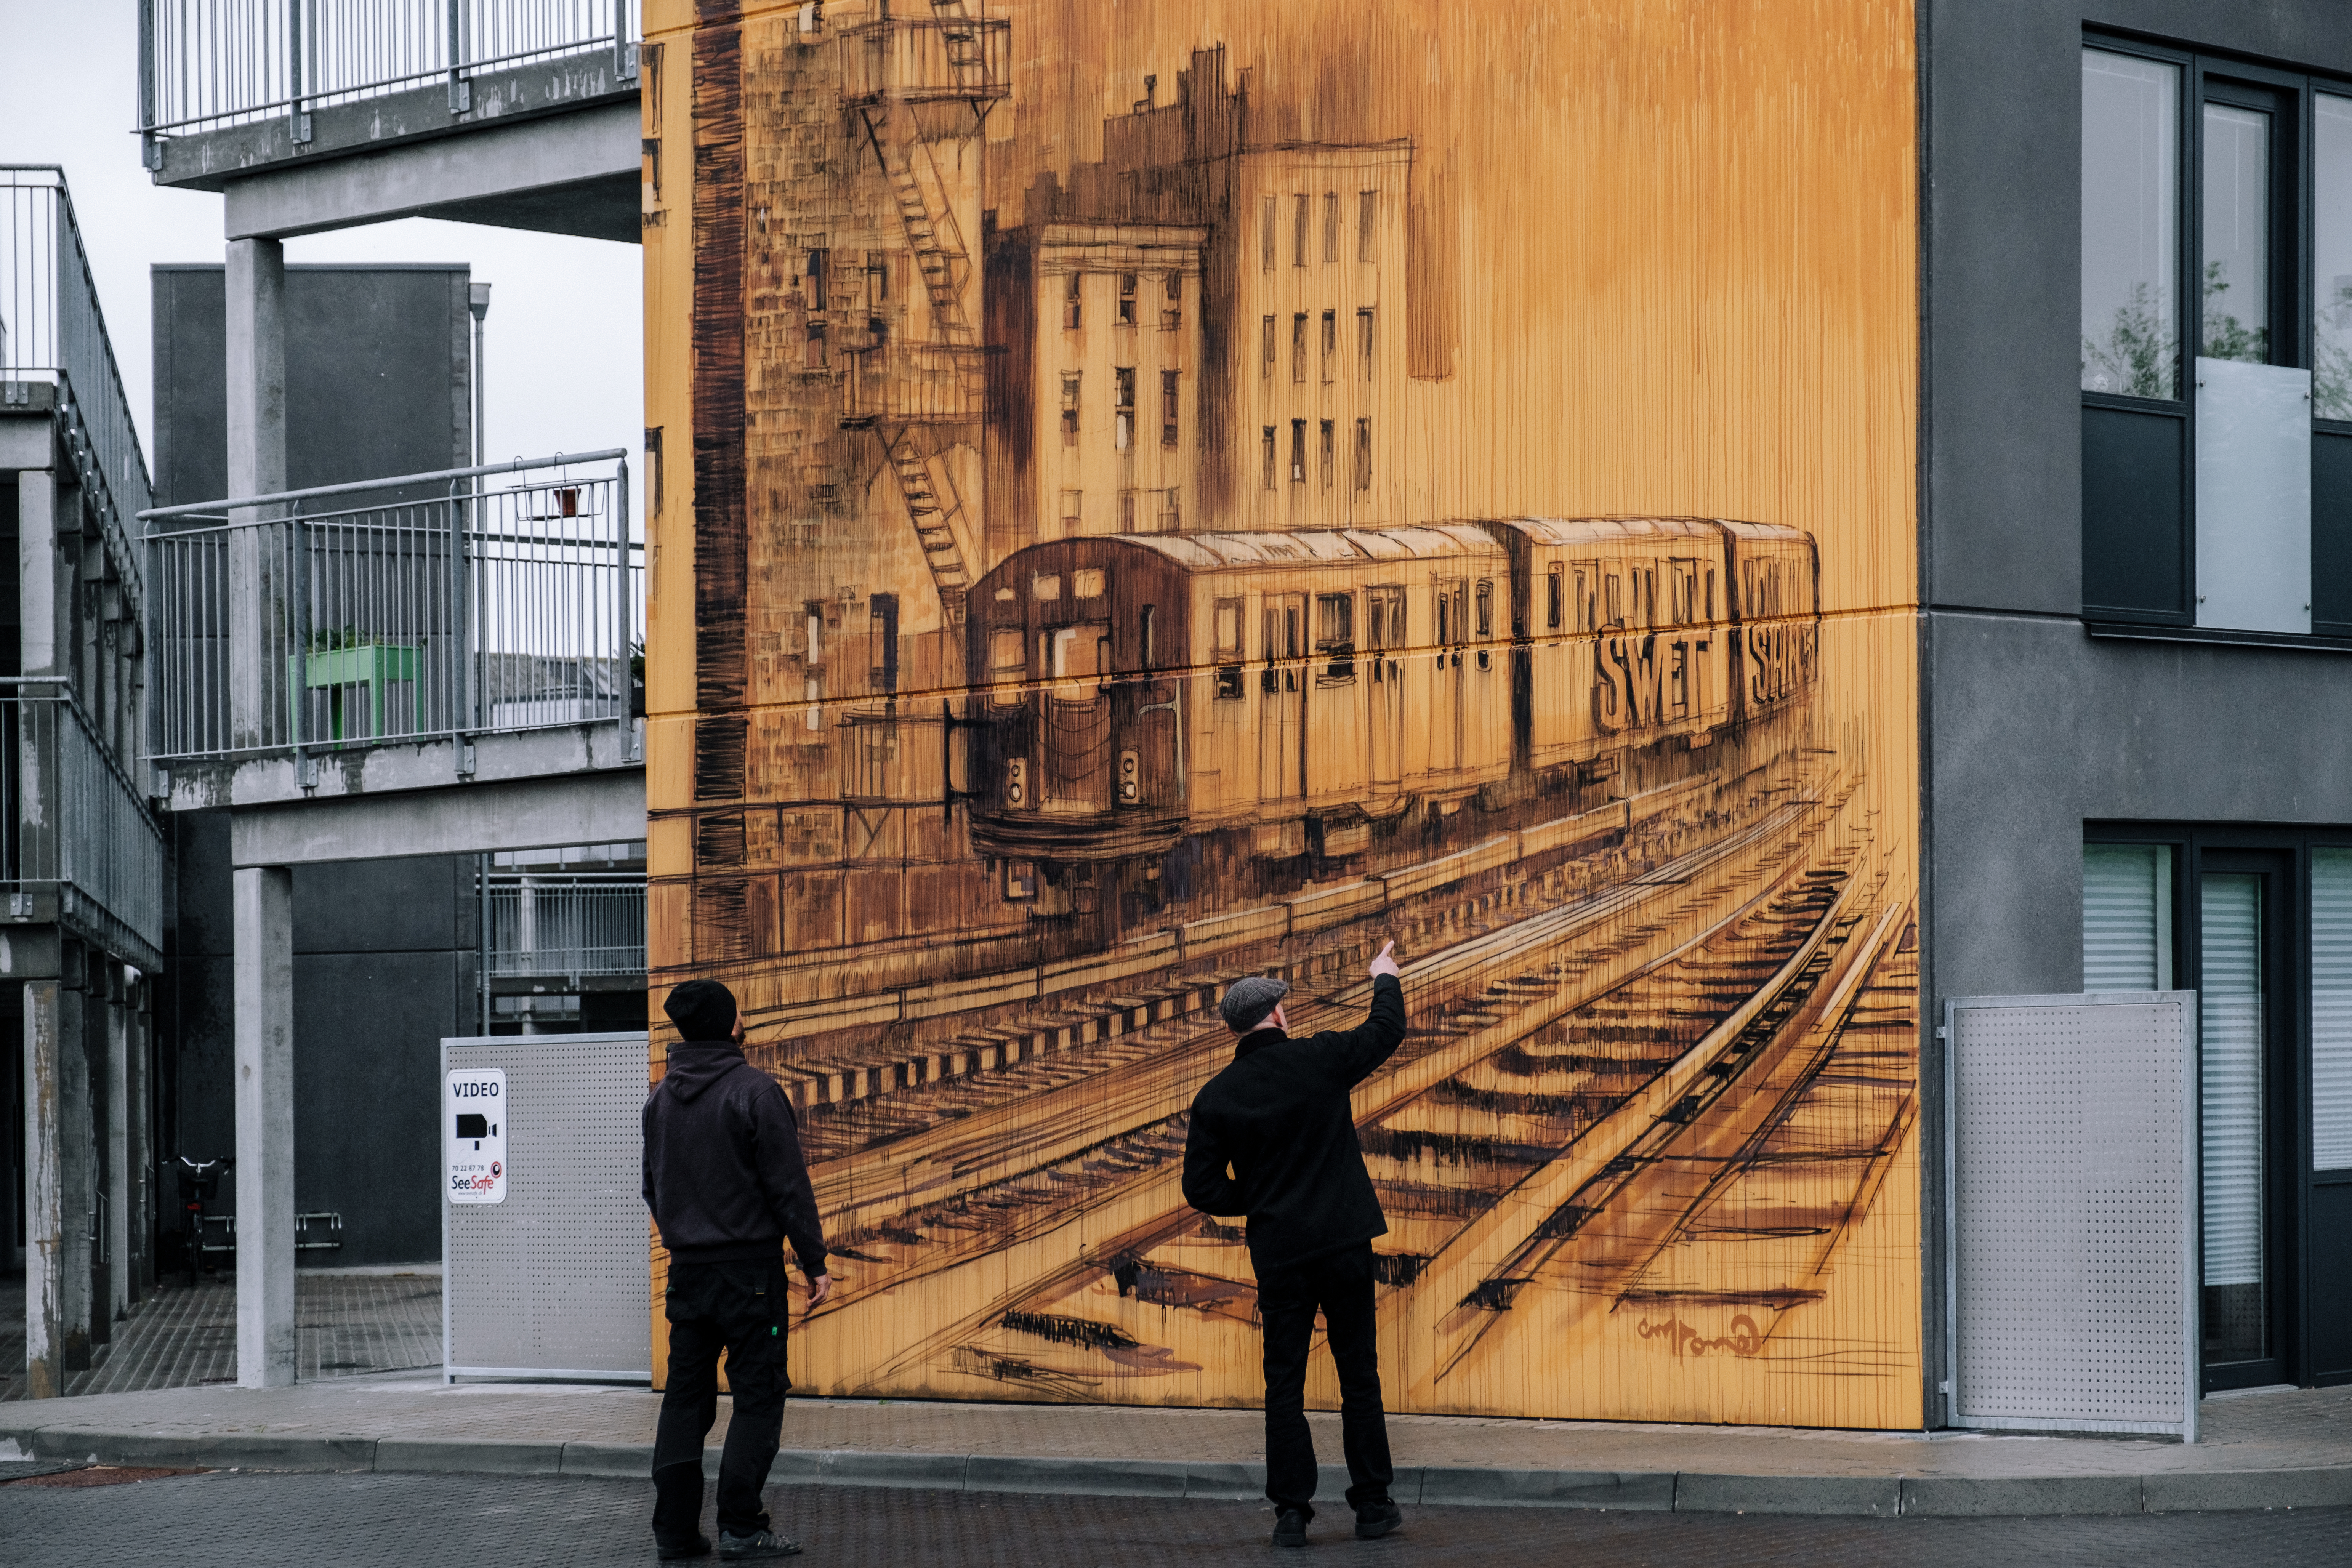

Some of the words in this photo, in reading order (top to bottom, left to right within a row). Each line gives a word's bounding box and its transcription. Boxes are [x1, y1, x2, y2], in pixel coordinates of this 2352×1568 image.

[1596, 625, 1712, 736] SWET
[453, 1082, 499, 1097] VIDEO
[451, 1175, 493, 1195] SeeSafe
